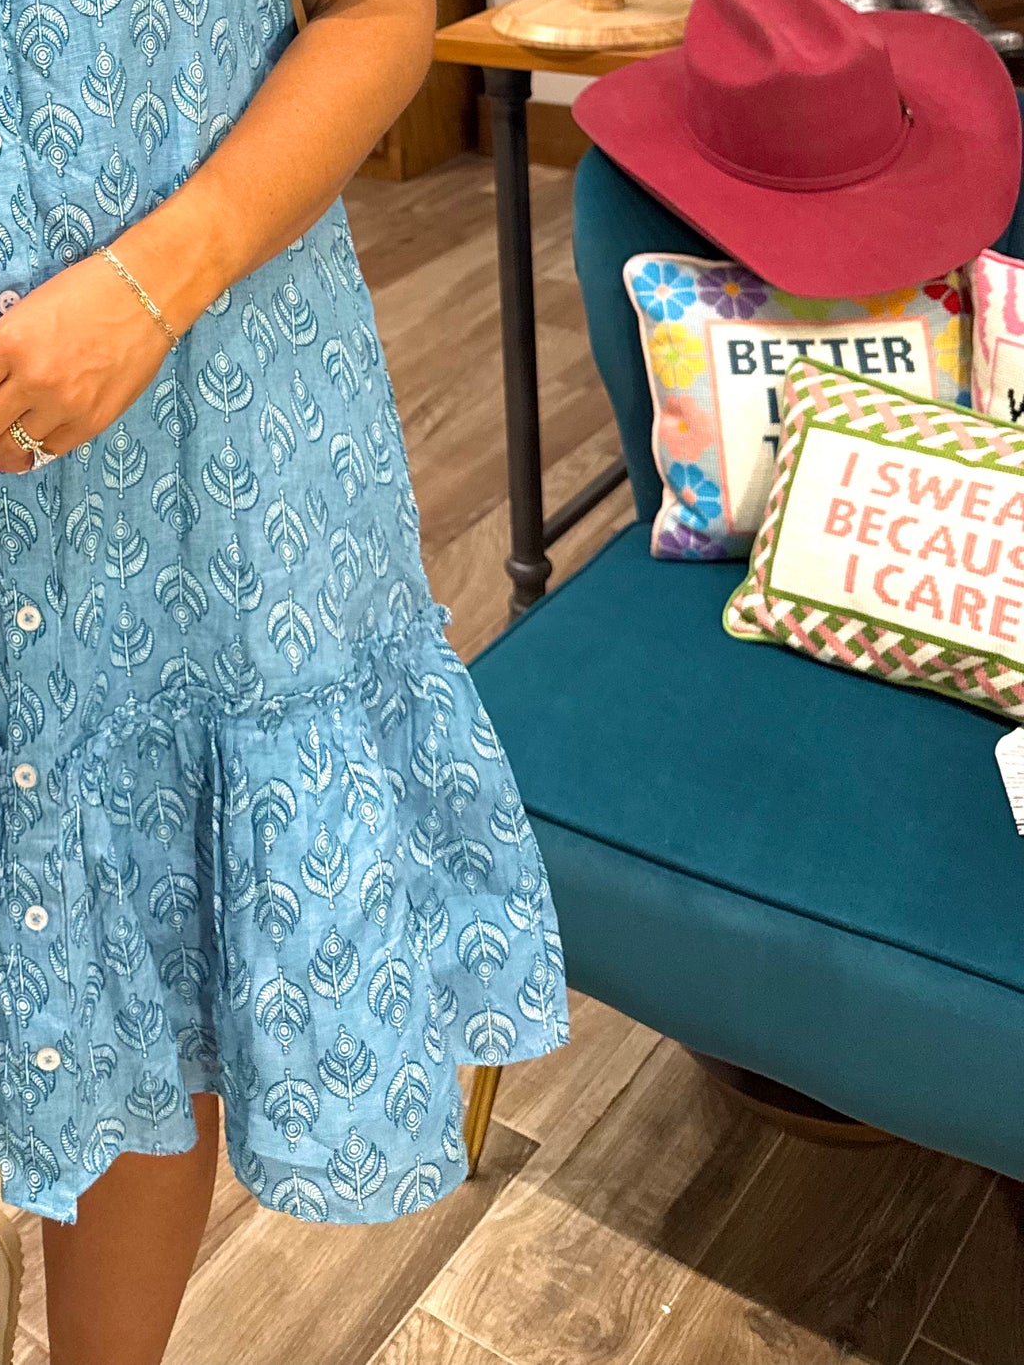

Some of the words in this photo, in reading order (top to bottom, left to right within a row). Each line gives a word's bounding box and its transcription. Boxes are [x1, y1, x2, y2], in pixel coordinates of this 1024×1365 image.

[728, 336, 916, 375] BETTER
[840, 452, 860, 487] I
[844, 554, 860, 594] I
[873, 564, 1023, 643] CARE
